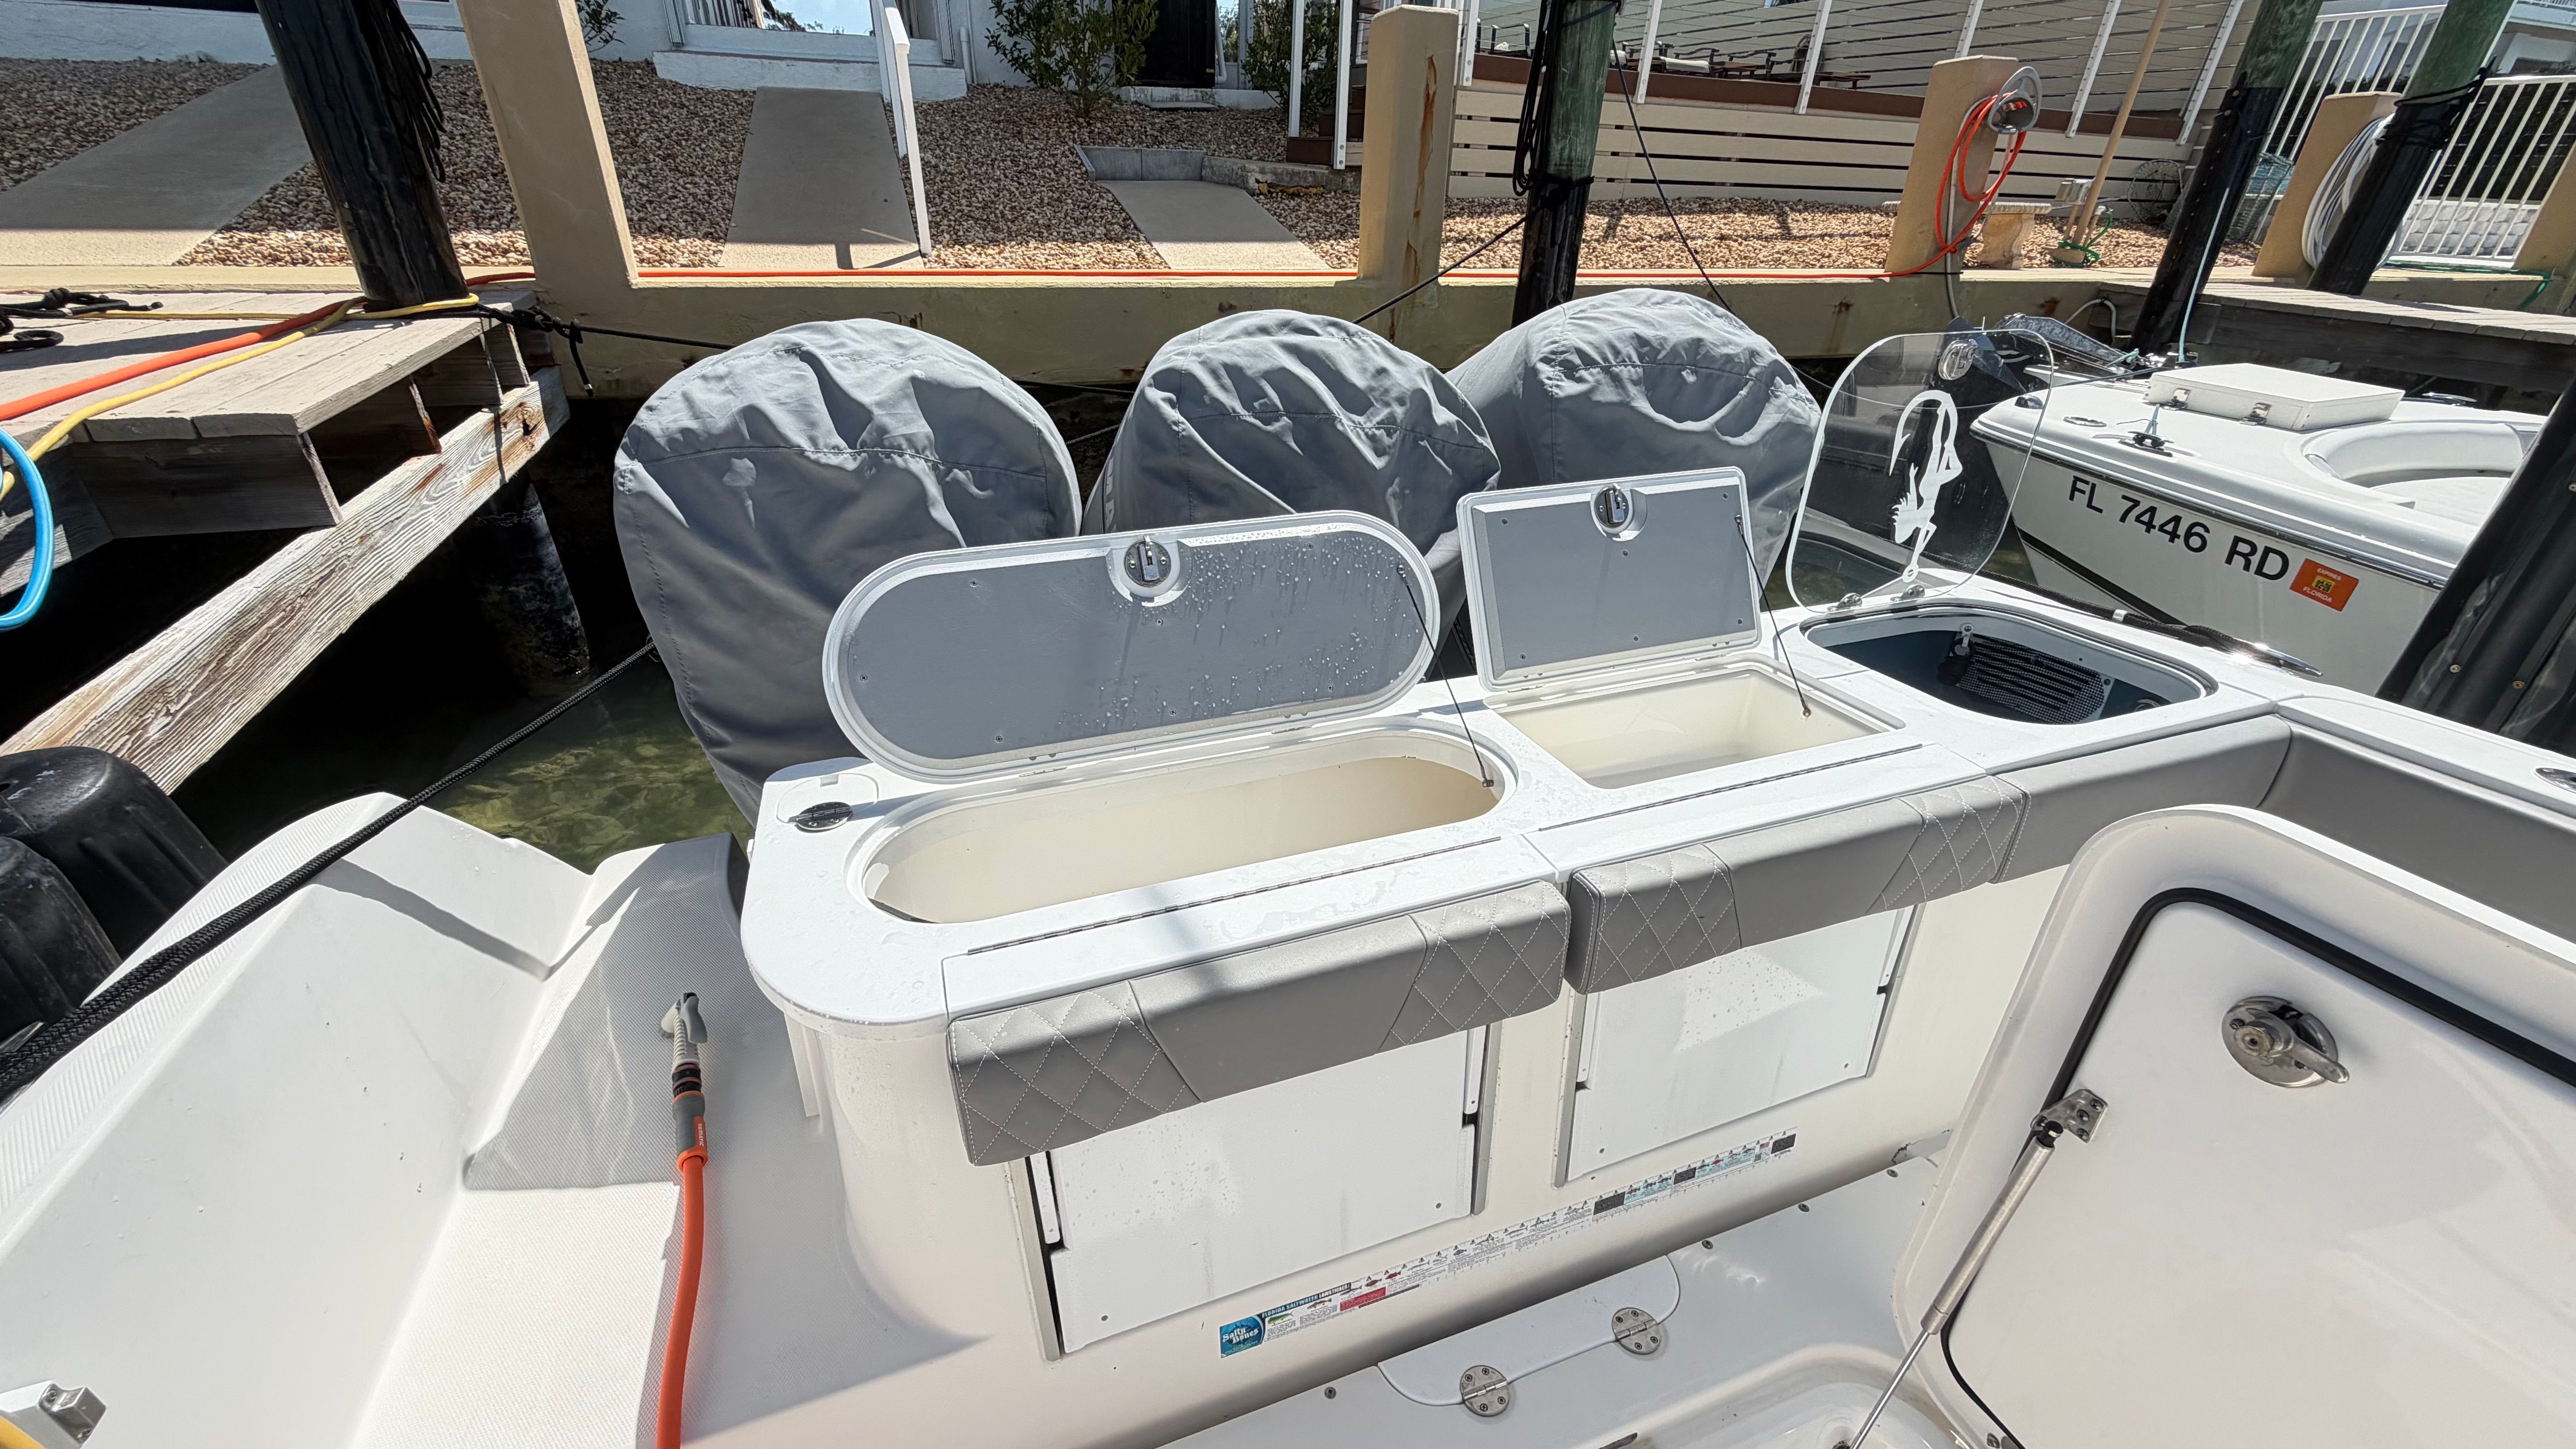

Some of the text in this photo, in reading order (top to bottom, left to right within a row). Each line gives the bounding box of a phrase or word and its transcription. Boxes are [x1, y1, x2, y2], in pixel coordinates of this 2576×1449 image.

[2069, 475, 2289, 580] FL 7446 RD
[2303, 586, 2332, 603] FLORIDA
[1262, 1306, 1285, 1318] FLORIDA
[1286, 1295, 1318, 1310] SALTWATER
[1223, 1327, 1246, 1343] Salty
[1232, 1328, 1259, 1344] Bones
